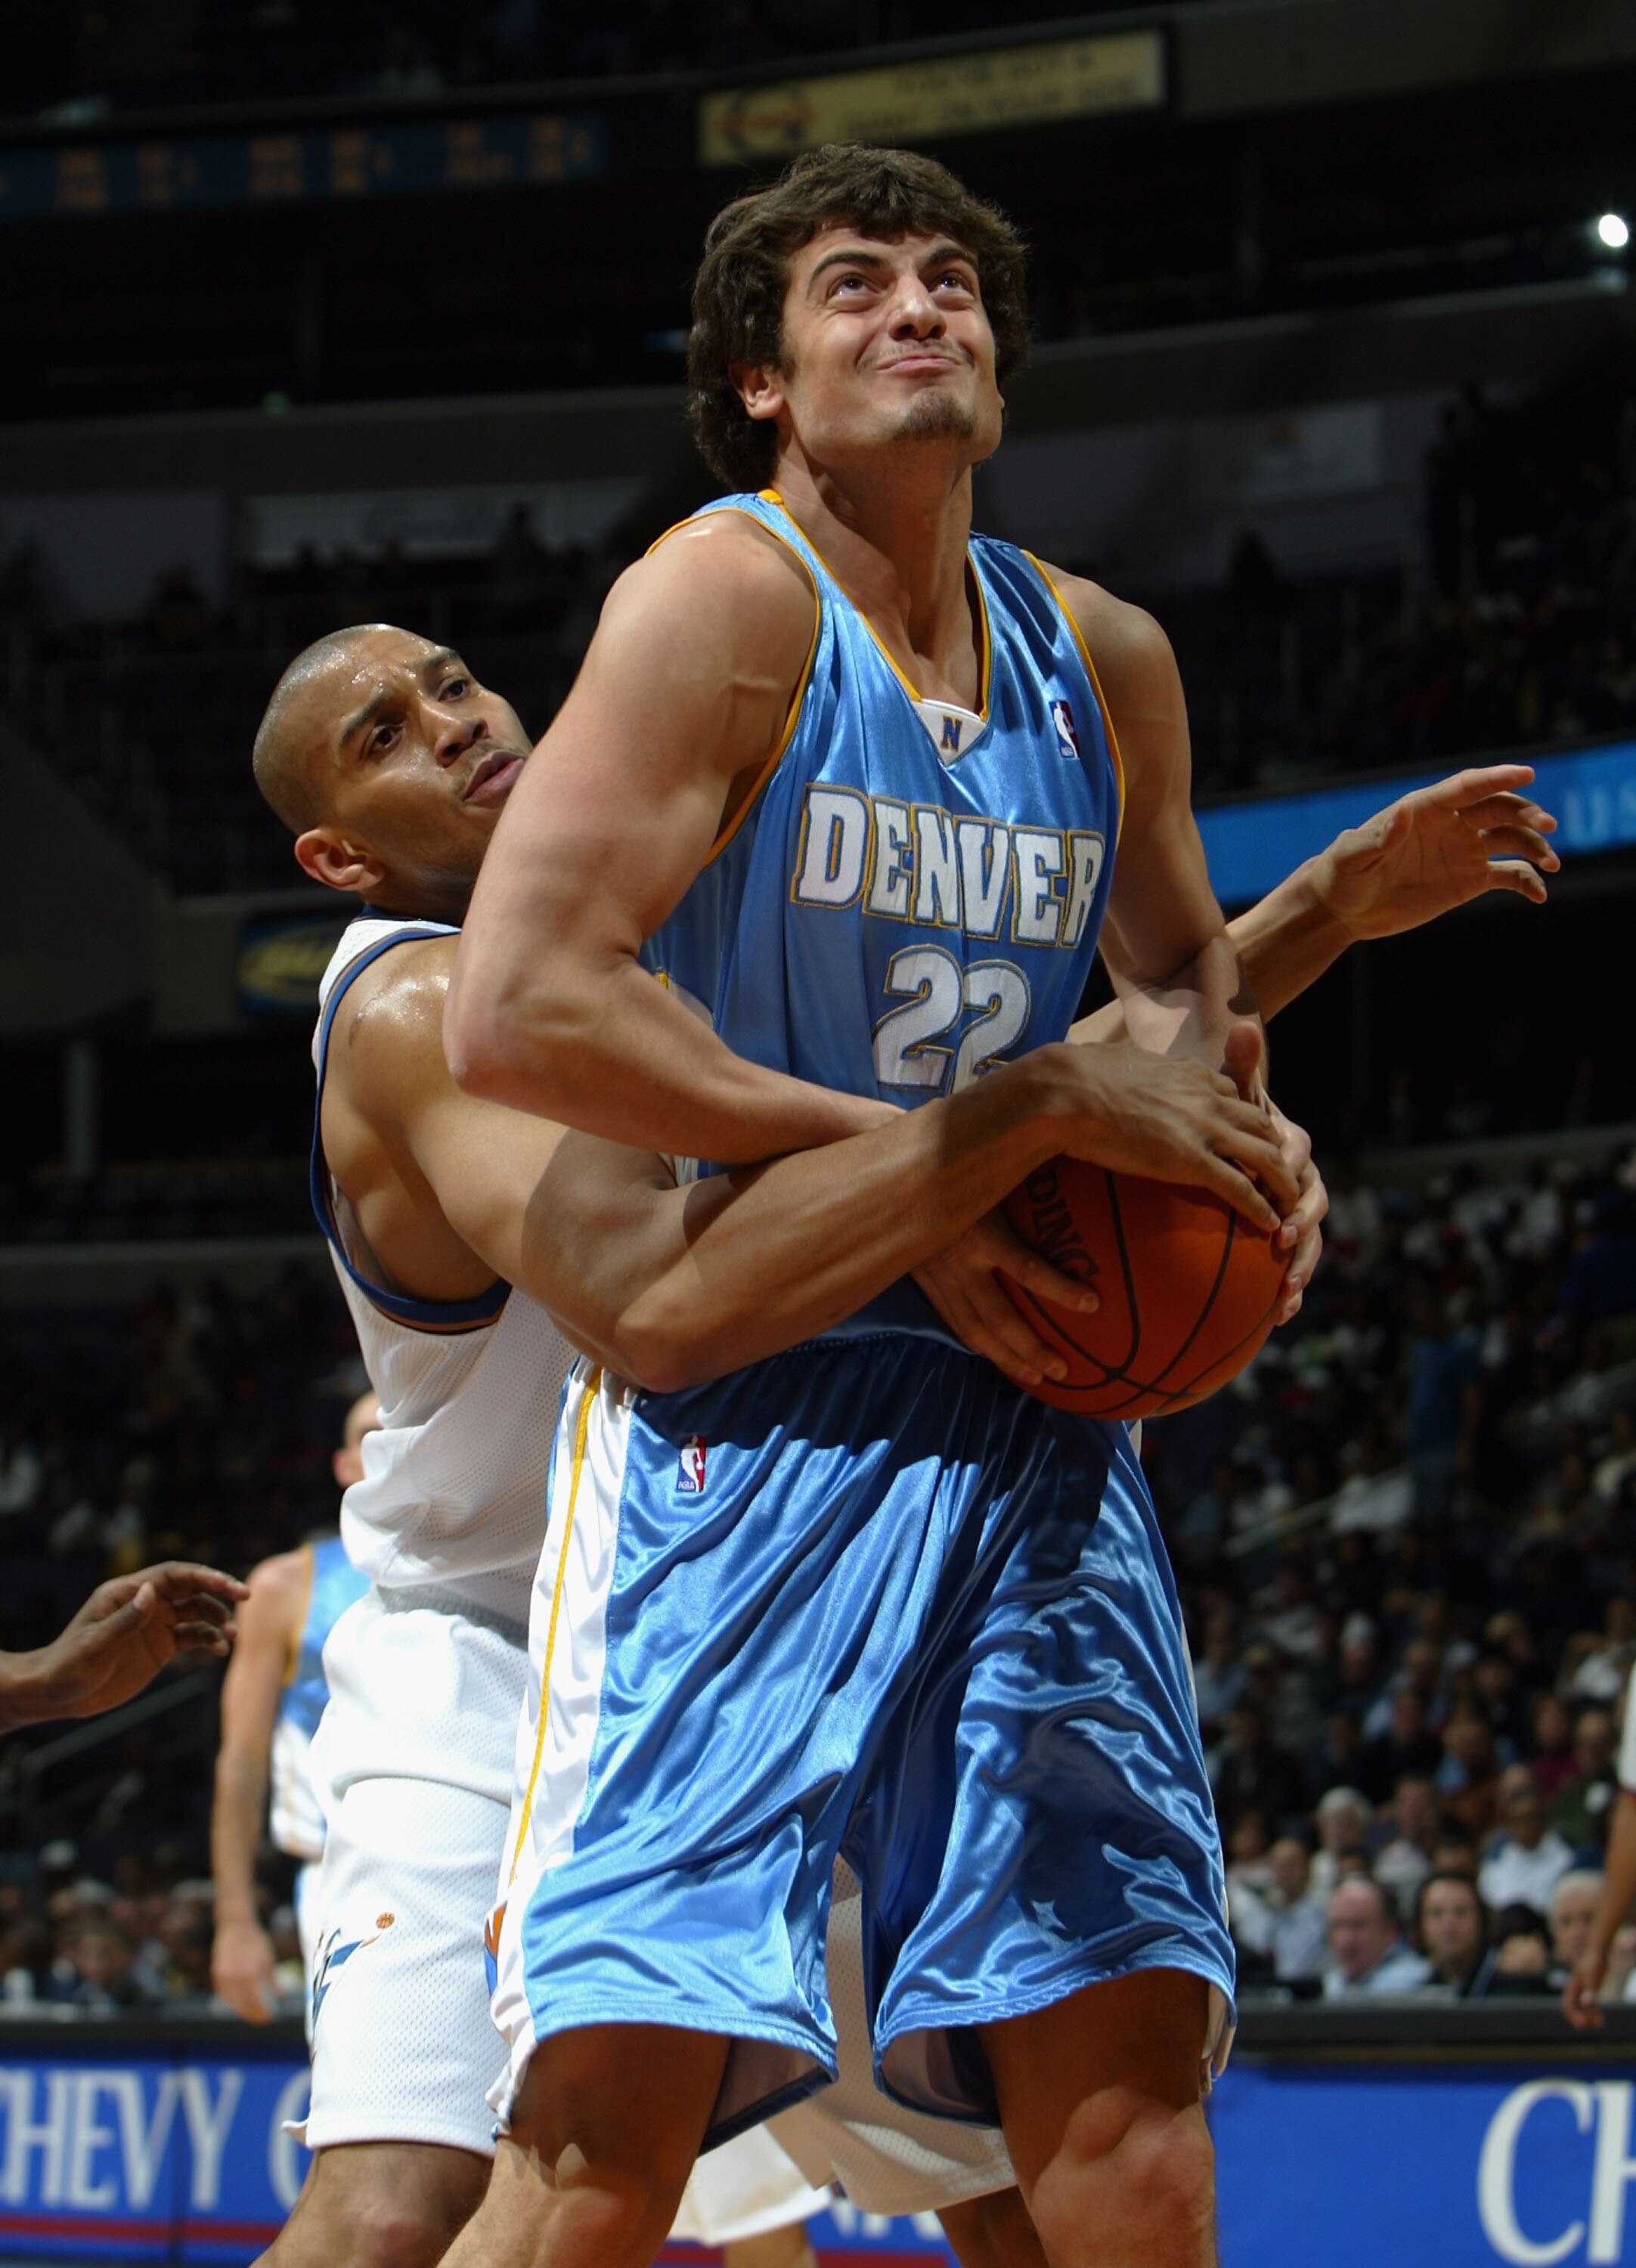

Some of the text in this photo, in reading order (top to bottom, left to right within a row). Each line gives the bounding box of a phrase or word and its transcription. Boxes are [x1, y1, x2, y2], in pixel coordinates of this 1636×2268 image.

[940, 714, 962, 751] N
[790, 782, 1106, 949] DENVER
[872, 943, 1031, 1095] 22
[0, 2065, 245, 2211] HEVY
